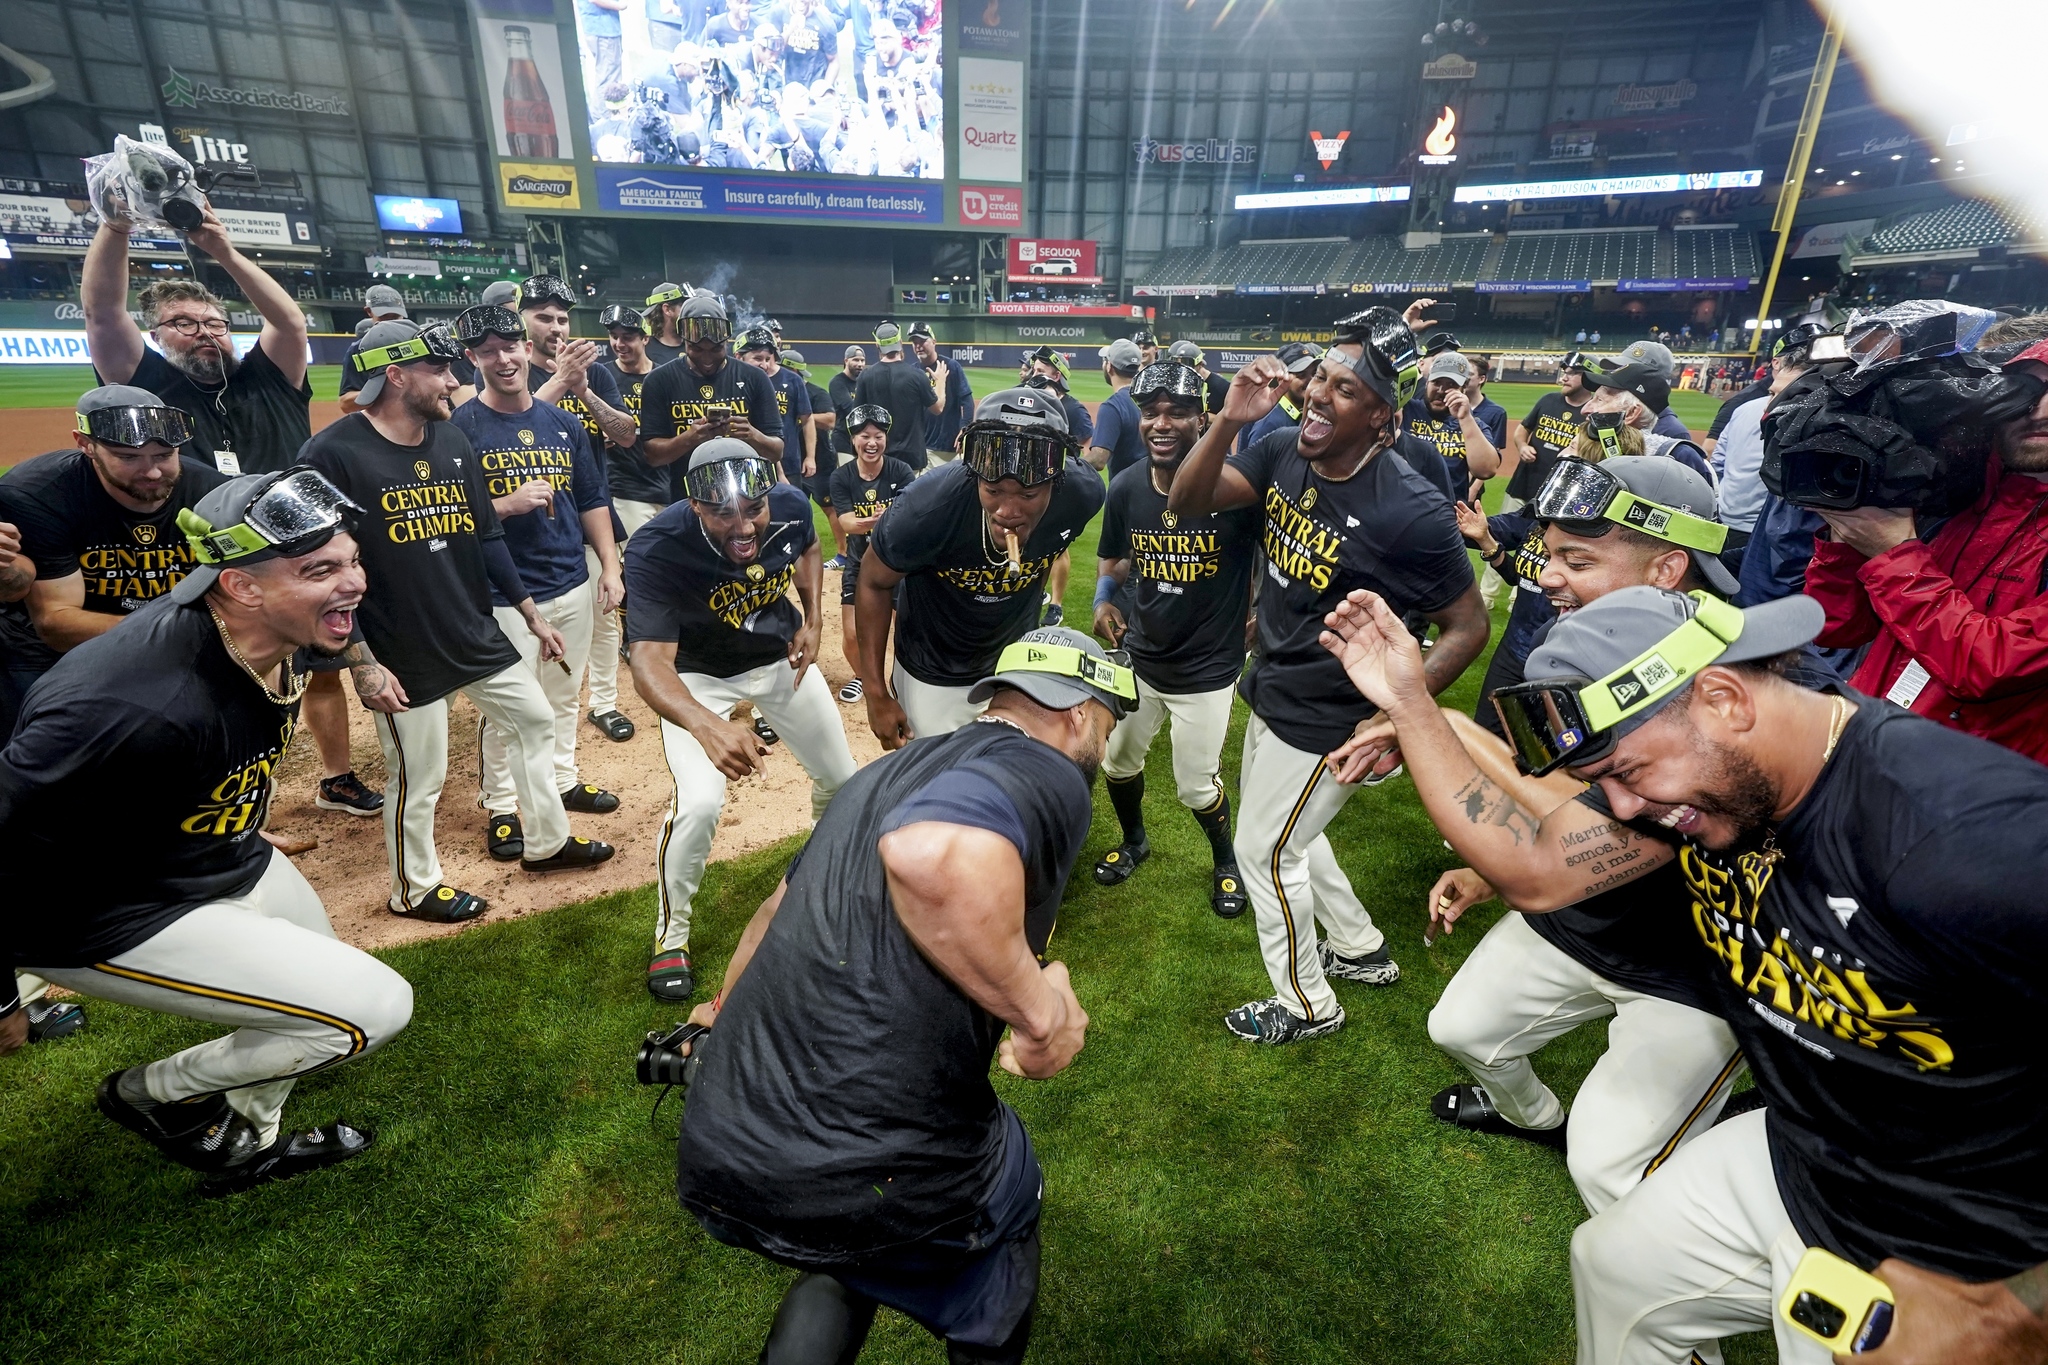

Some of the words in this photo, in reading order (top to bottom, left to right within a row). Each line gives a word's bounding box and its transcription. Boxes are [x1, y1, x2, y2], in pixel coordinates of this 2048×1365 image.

[964, 26, 1020, 38] POTAWATOMI
[1425, 62, 1474, 78] Johnsonville
[1614, 78, 1697, 104] Johnsonville
[196, 82, 301, 110] Associated
[303, 95, 348, 116] Bank
[964, 126, 1016, 147] Quartz
[189, 134, 249, 164] Lite
[1316, 140, 1344, 149] VIZZY
[514, 179, 566, 194] SARGENTO
[620, 188, 667, 200] AMERICAN
[671, 190, 702, 200] FAMILY
[1486, 188, 1498, 198] NL
[1502, 184, 1546, 198] CENTRAL
[1551, 181, 1598, 195] DIVISION
[1602, 178, 1669, 192] CHAMPIONS
[626, 198, 696, 207] INSURANCE
[725, 188, 764, 204] Insure
[768, 191, 824, 209] carefully,
[826, 194, 864, 208] dream
[867, 194, 926, 212] fearlessly.
[989, 194, 1004, 202] uw
[20, 204, 49, 213] BREW
[989, 202, 1018, 211] credit
[989, 211, 1019, 221] union
[248, 220, 281, 228] BREWED
[232, 228, 280, 236] MILWAUKEE
[36, 236, 66, 245] GREAT
[1040, 248, 1082, 258] SEQUOIA
[384, 264, 418, 272] Associated
[446, 265, 471, 274] POWER
[474, 266, 500, 276] ALLEY
[1351, 284, 1373, 292] 620
[1374, 283, 1410, 292] WTMJ
[1478, 283, 1521, 291] WINTRUST
[991, 304, 1023, 314] TOYOTA
[1025, 304, 1070, 314] TERRITORY
[1018, 327, 1085, 338] TOYOTA.COM
[952, 346, 984, 364] meijer
[1539, 416, 1580, 436] CENTRA
[1536, 428, 1572, 447] CHAMP
[482, 450, 573, 471] CENTRAL
[506, 467, 562, 476] DIVISION
[407, 504, 458, 519] DIVISION
[1578, 504, 1590, 515] 31
[1651, 512, 1667, 522] NEW
[388, 512, 475, 544] CHAMPS
[1266, 487, 1340, 564] CENTRAL
[1648, 520, 1664, 529] ERA
[1132, 533, 1221, 554] CENTRAL
[1268, 519, 1312, 560] DIVISION
[1144, 552, 1200, 562] DIVISION
[1264, 526, 1333, 590] HAMPS
[1520, 550, 1549, 567] DIVISI
[1136, 557, 1218, 582] CHAMPS
[1986, 571, 2025, 583] Coumbia
[83, 572, 188, 598] CHAMP
[1098, 666, 1112, 676] NEW
[1641, 659, 1664, 679] NEW
[1097, 675, 1112, 683] ERA
[1646, 668, 1670, 686] ERA
[1559, 821, 1624, 852] ¡Marine
[1566, 841, 1618, 867] somos,
[1619, 836, 1629, 849] y
[1591, 863, 1605, 875] el
[1609, 848, 1641, 869] mar
[1585, 854, 1662, 895] andamos!
